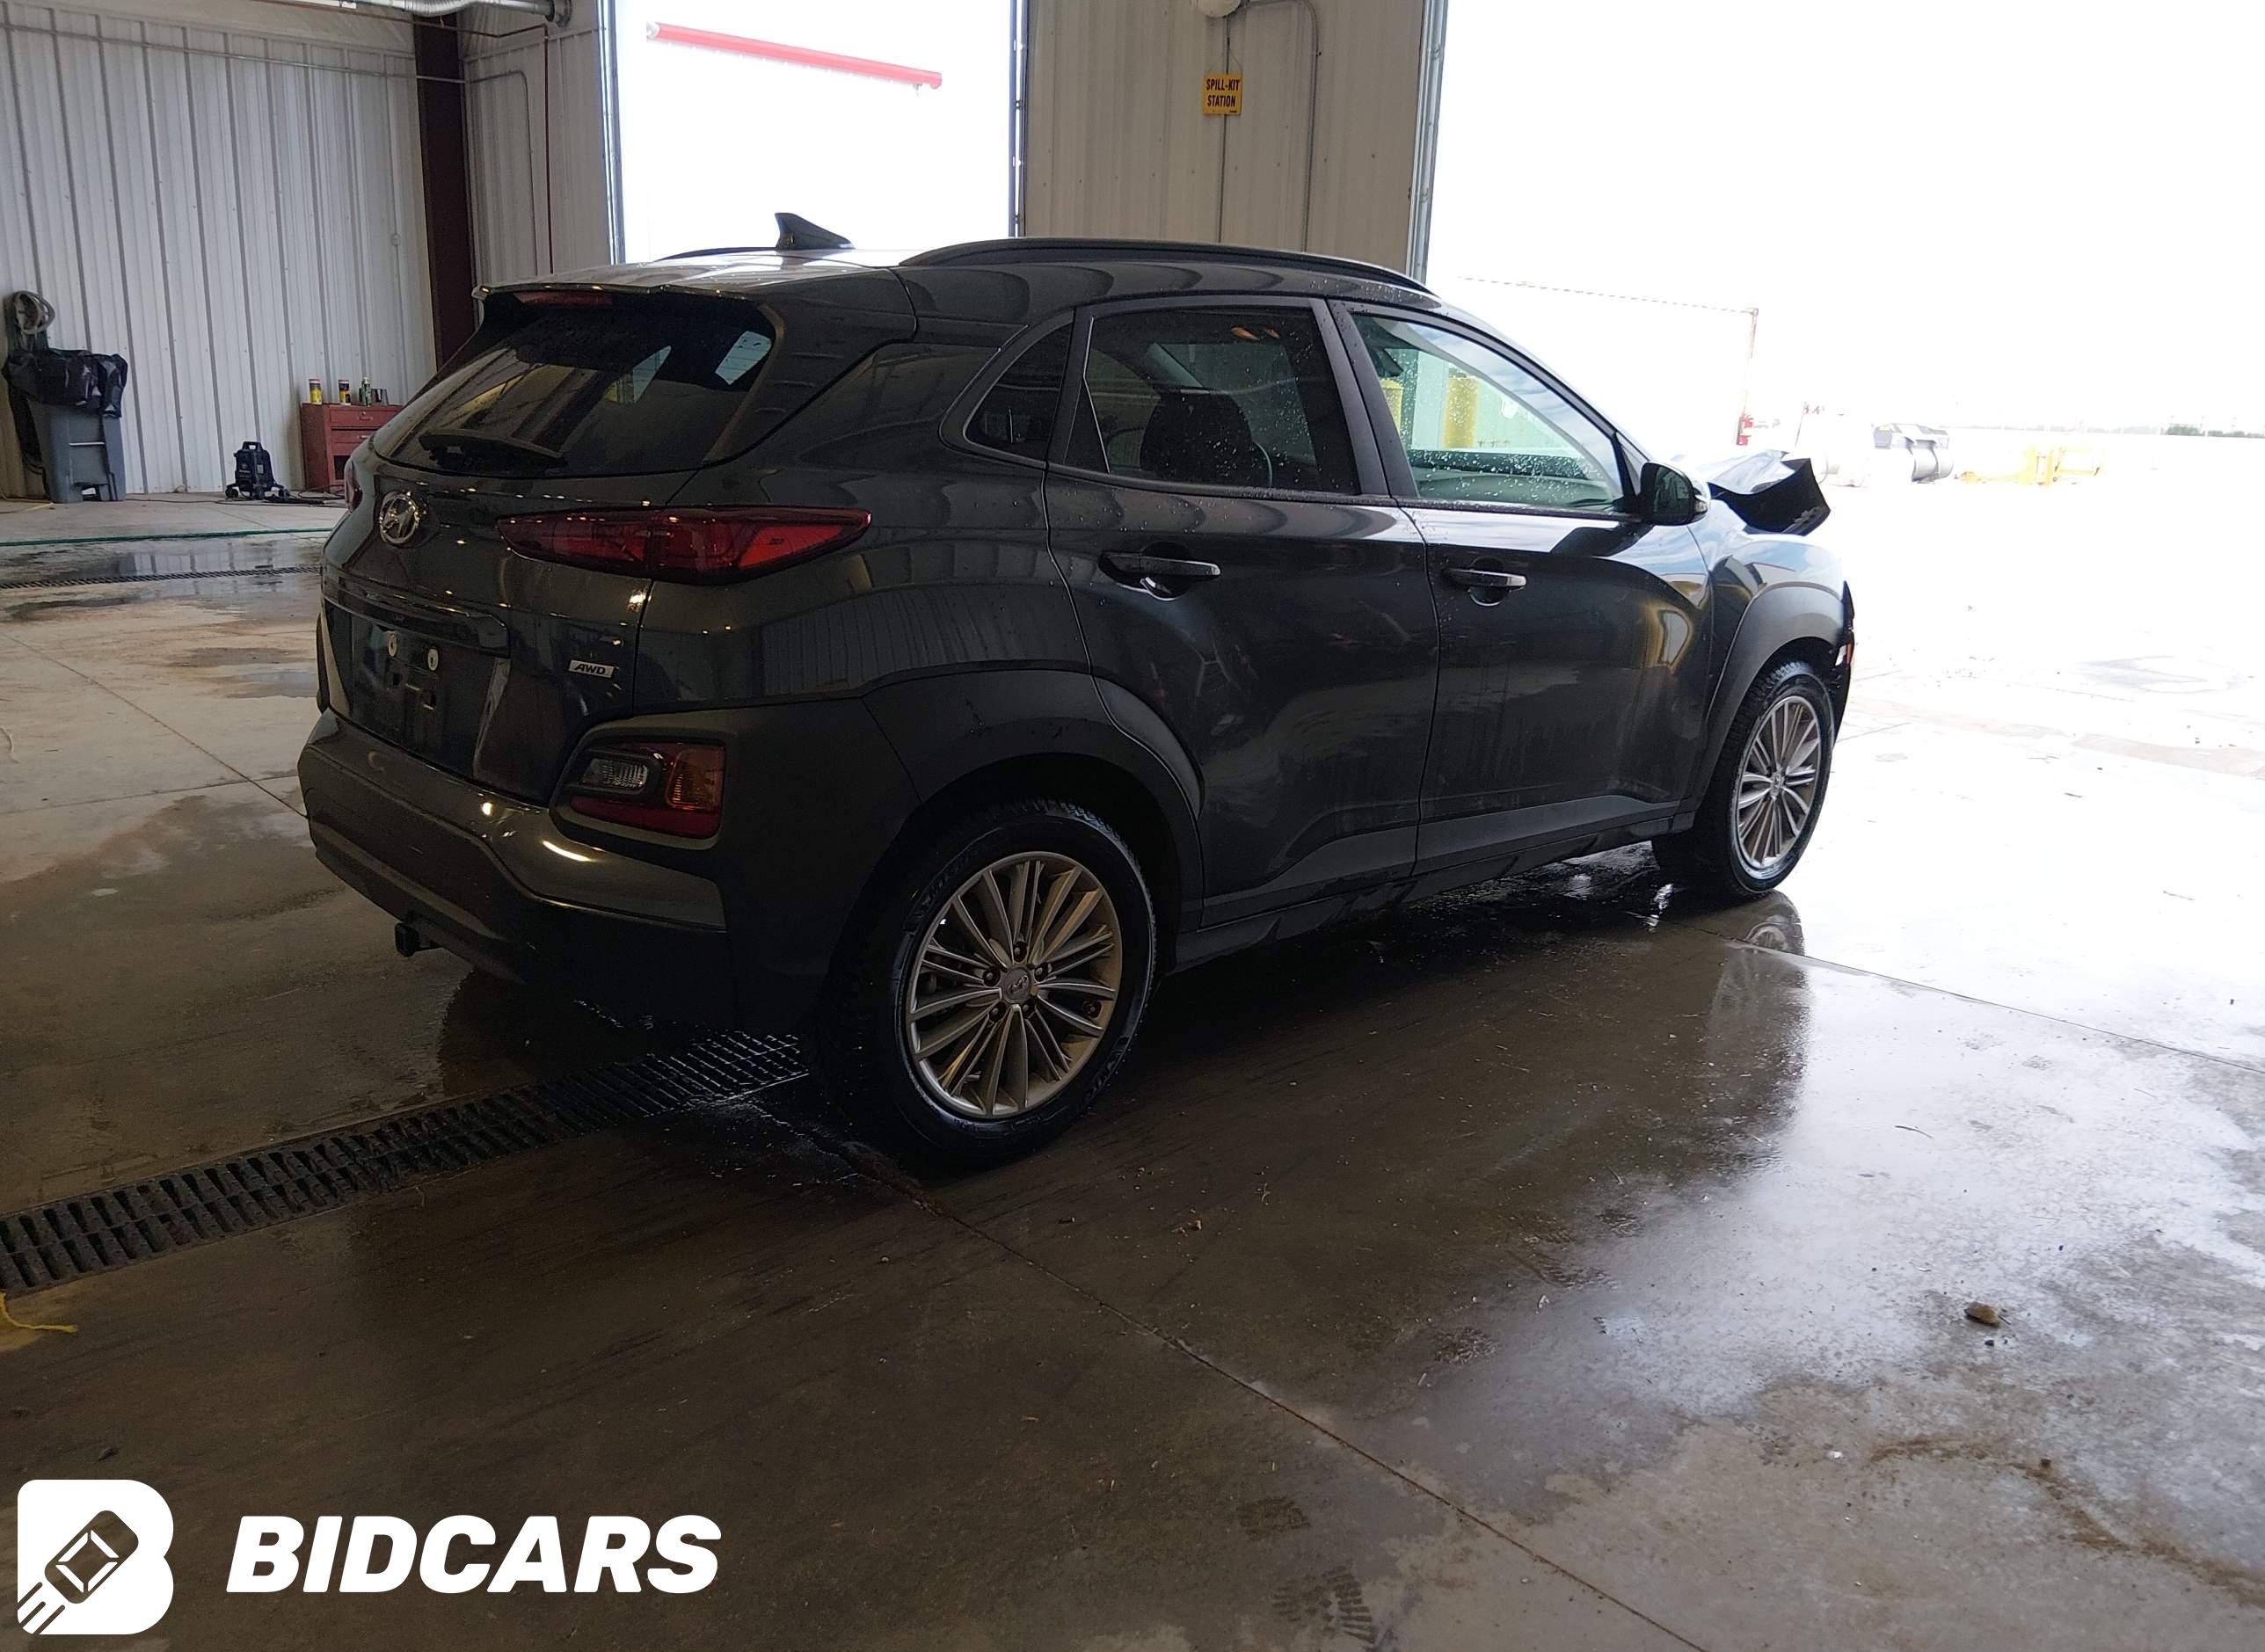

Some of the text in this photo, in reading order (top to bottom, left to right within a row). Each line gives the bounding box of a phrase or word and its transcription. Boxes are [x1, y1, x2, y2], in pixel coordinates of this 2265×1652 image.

[1205, 78, 1241, 91] SPILL-KIT
[1207, 94, 1236, 107] STATION
[574, 662, 607, 675] AWD
